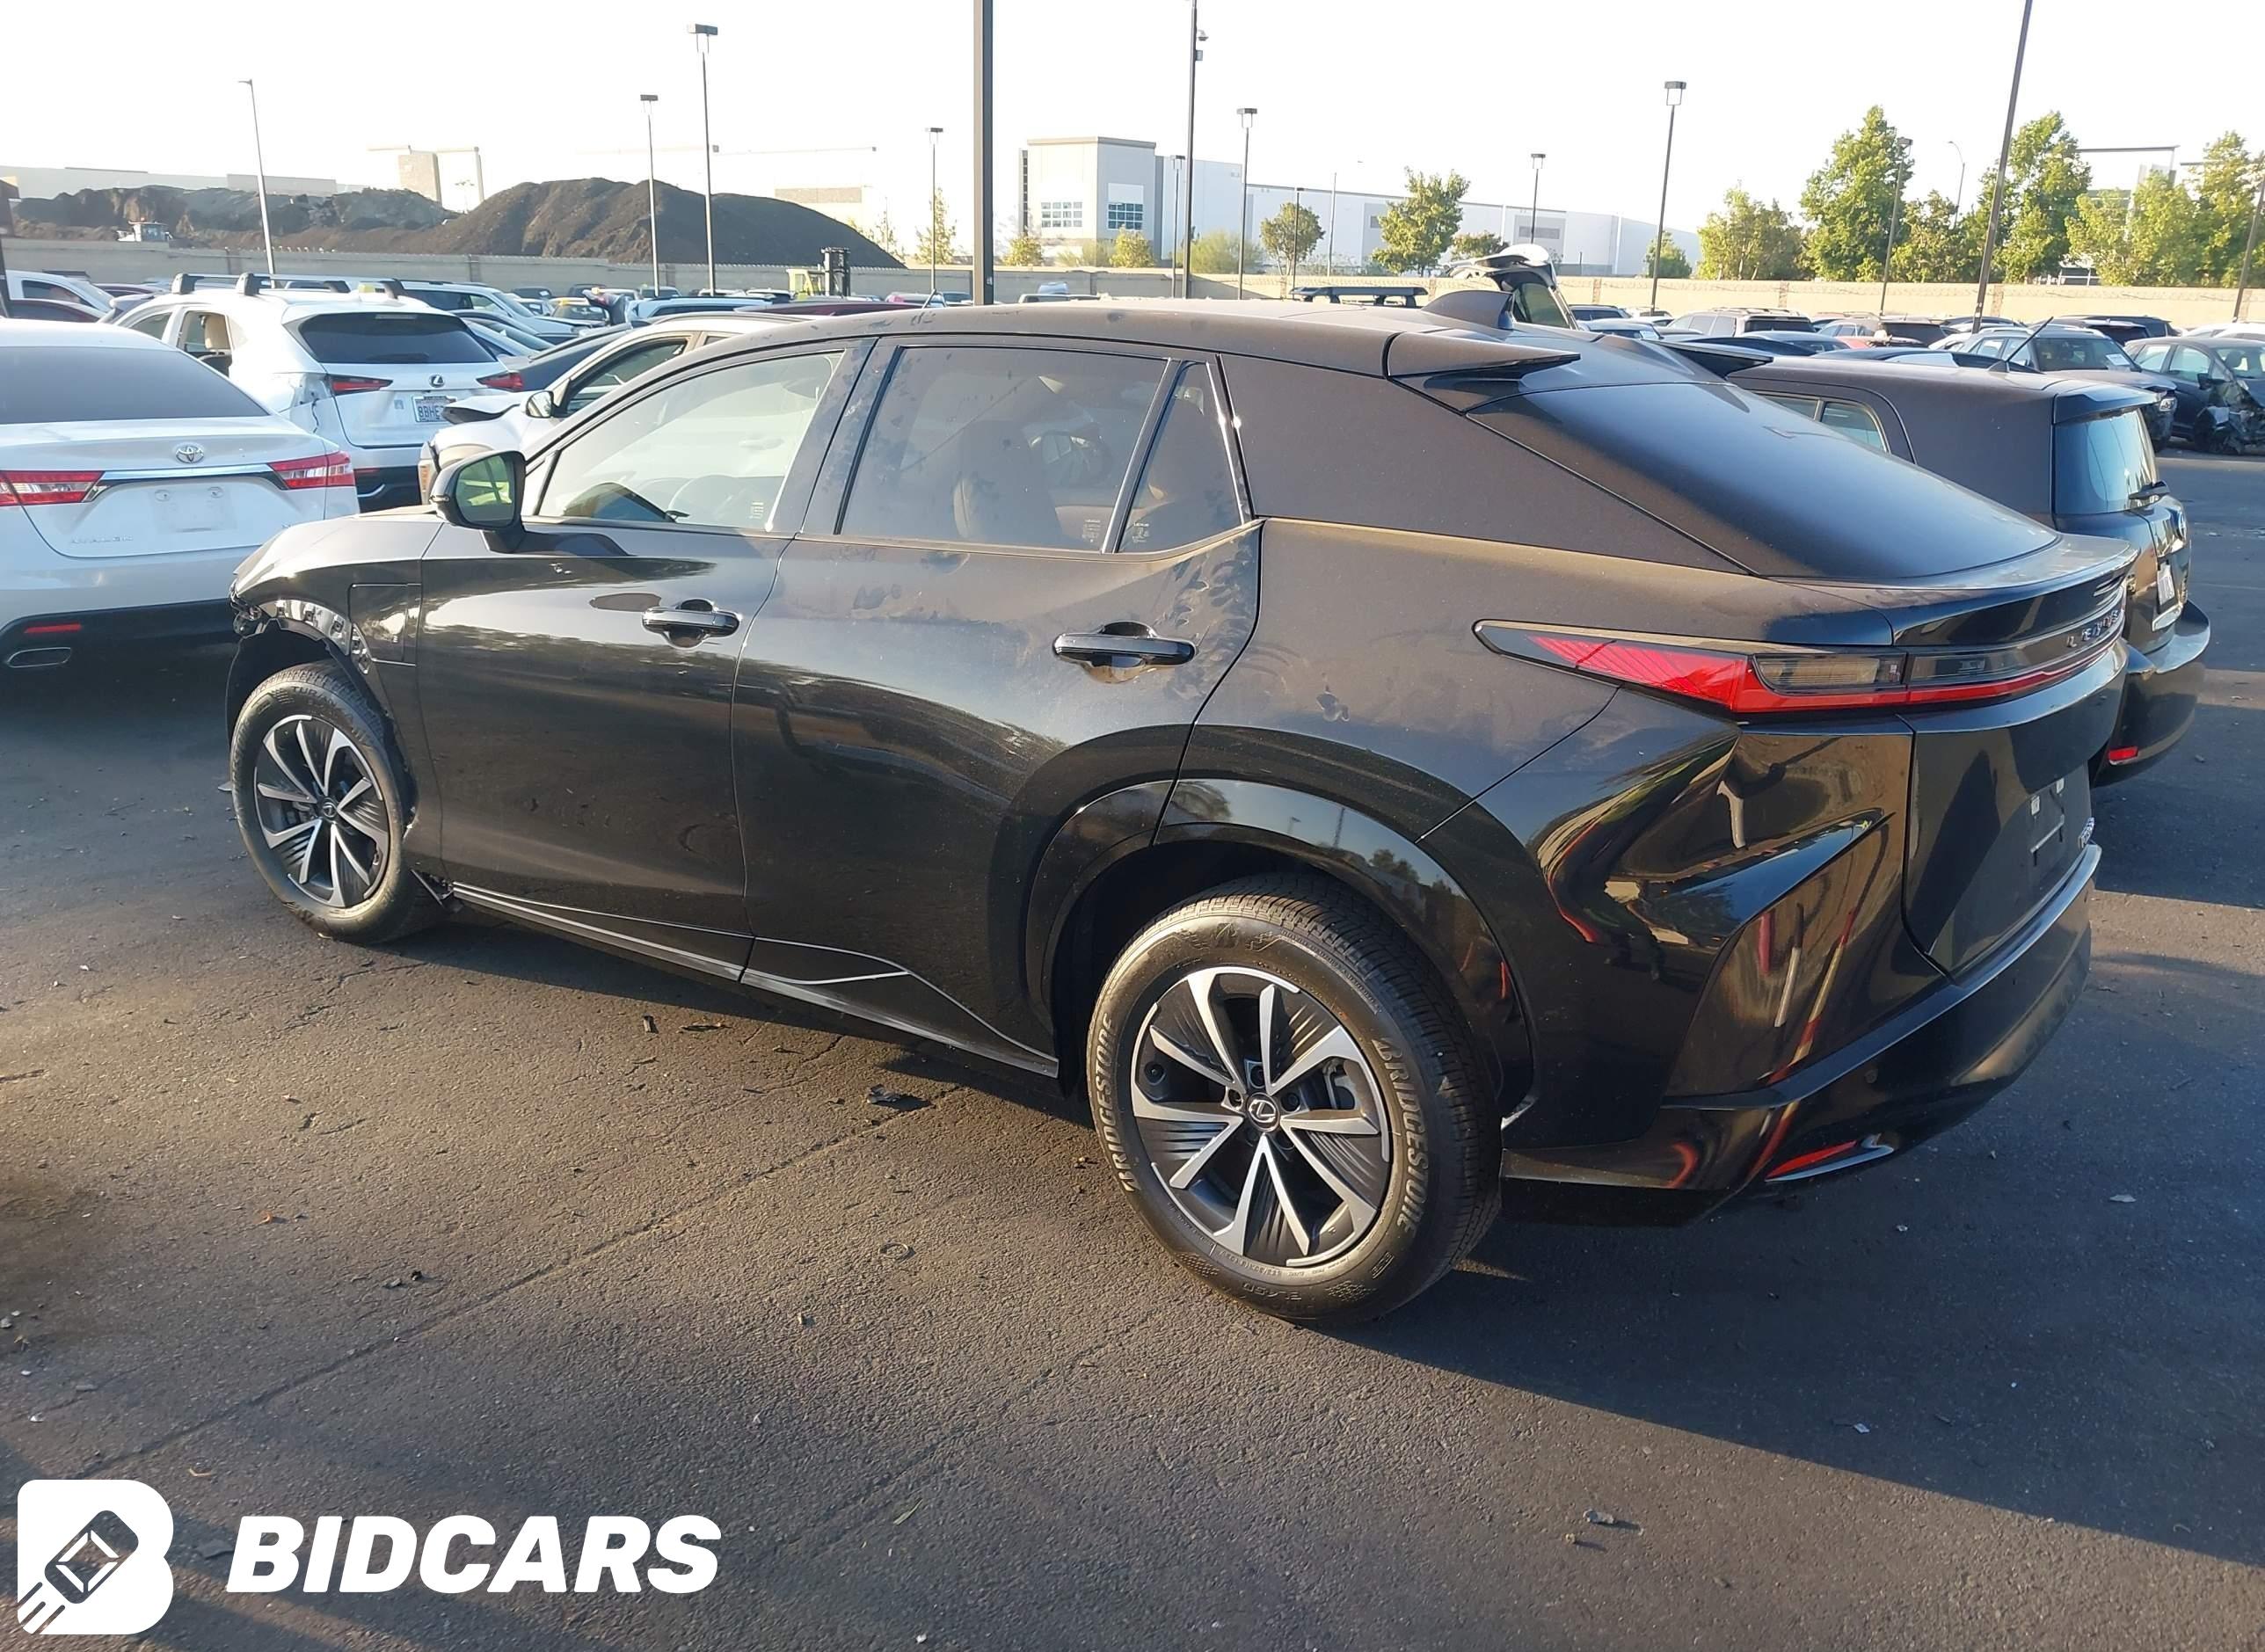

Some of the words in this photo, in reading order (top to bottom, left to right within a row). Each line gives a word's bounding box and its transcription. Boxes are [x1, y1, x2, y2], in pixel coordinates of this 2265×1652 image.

[417, 405, 444, 418] 8BHE
[1095, 1012, 1141, 1191] BRIDGESTONE
[1371, 1037, 1429, 1238] BRIDGESTONE
